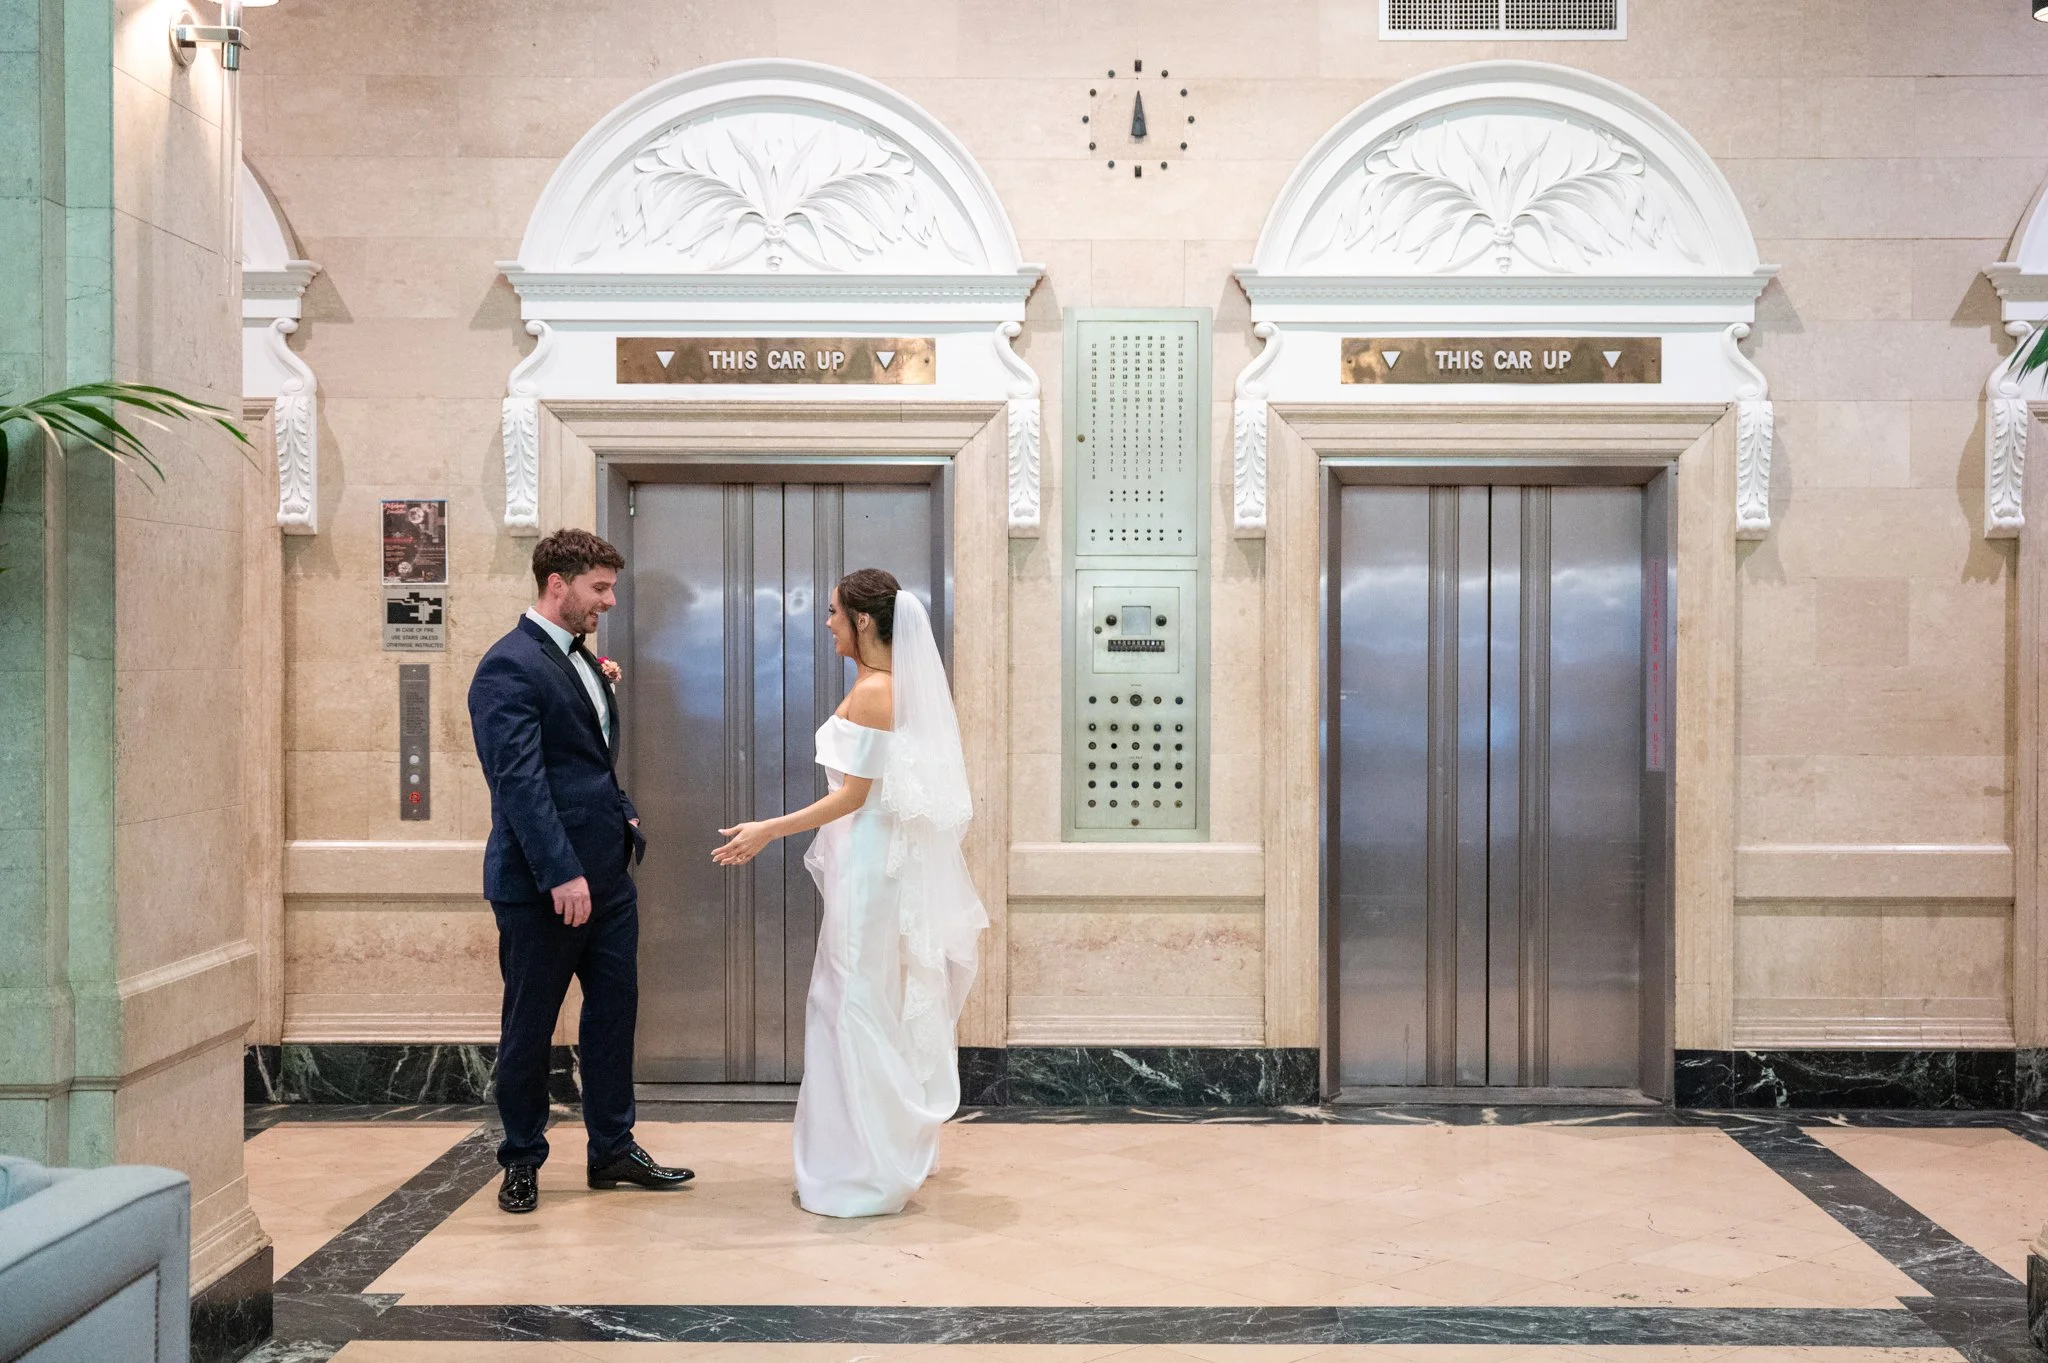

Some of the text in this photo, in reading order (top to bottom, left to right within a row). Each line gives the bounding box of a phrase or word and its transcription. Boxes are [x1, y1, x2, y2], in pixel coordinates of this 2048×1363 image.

[709, 350, 845, 370] THIS CAR UP
[1435, 350, 1572, 370] THIS CAR UP
[1653, 702, 1659, 722] IN
